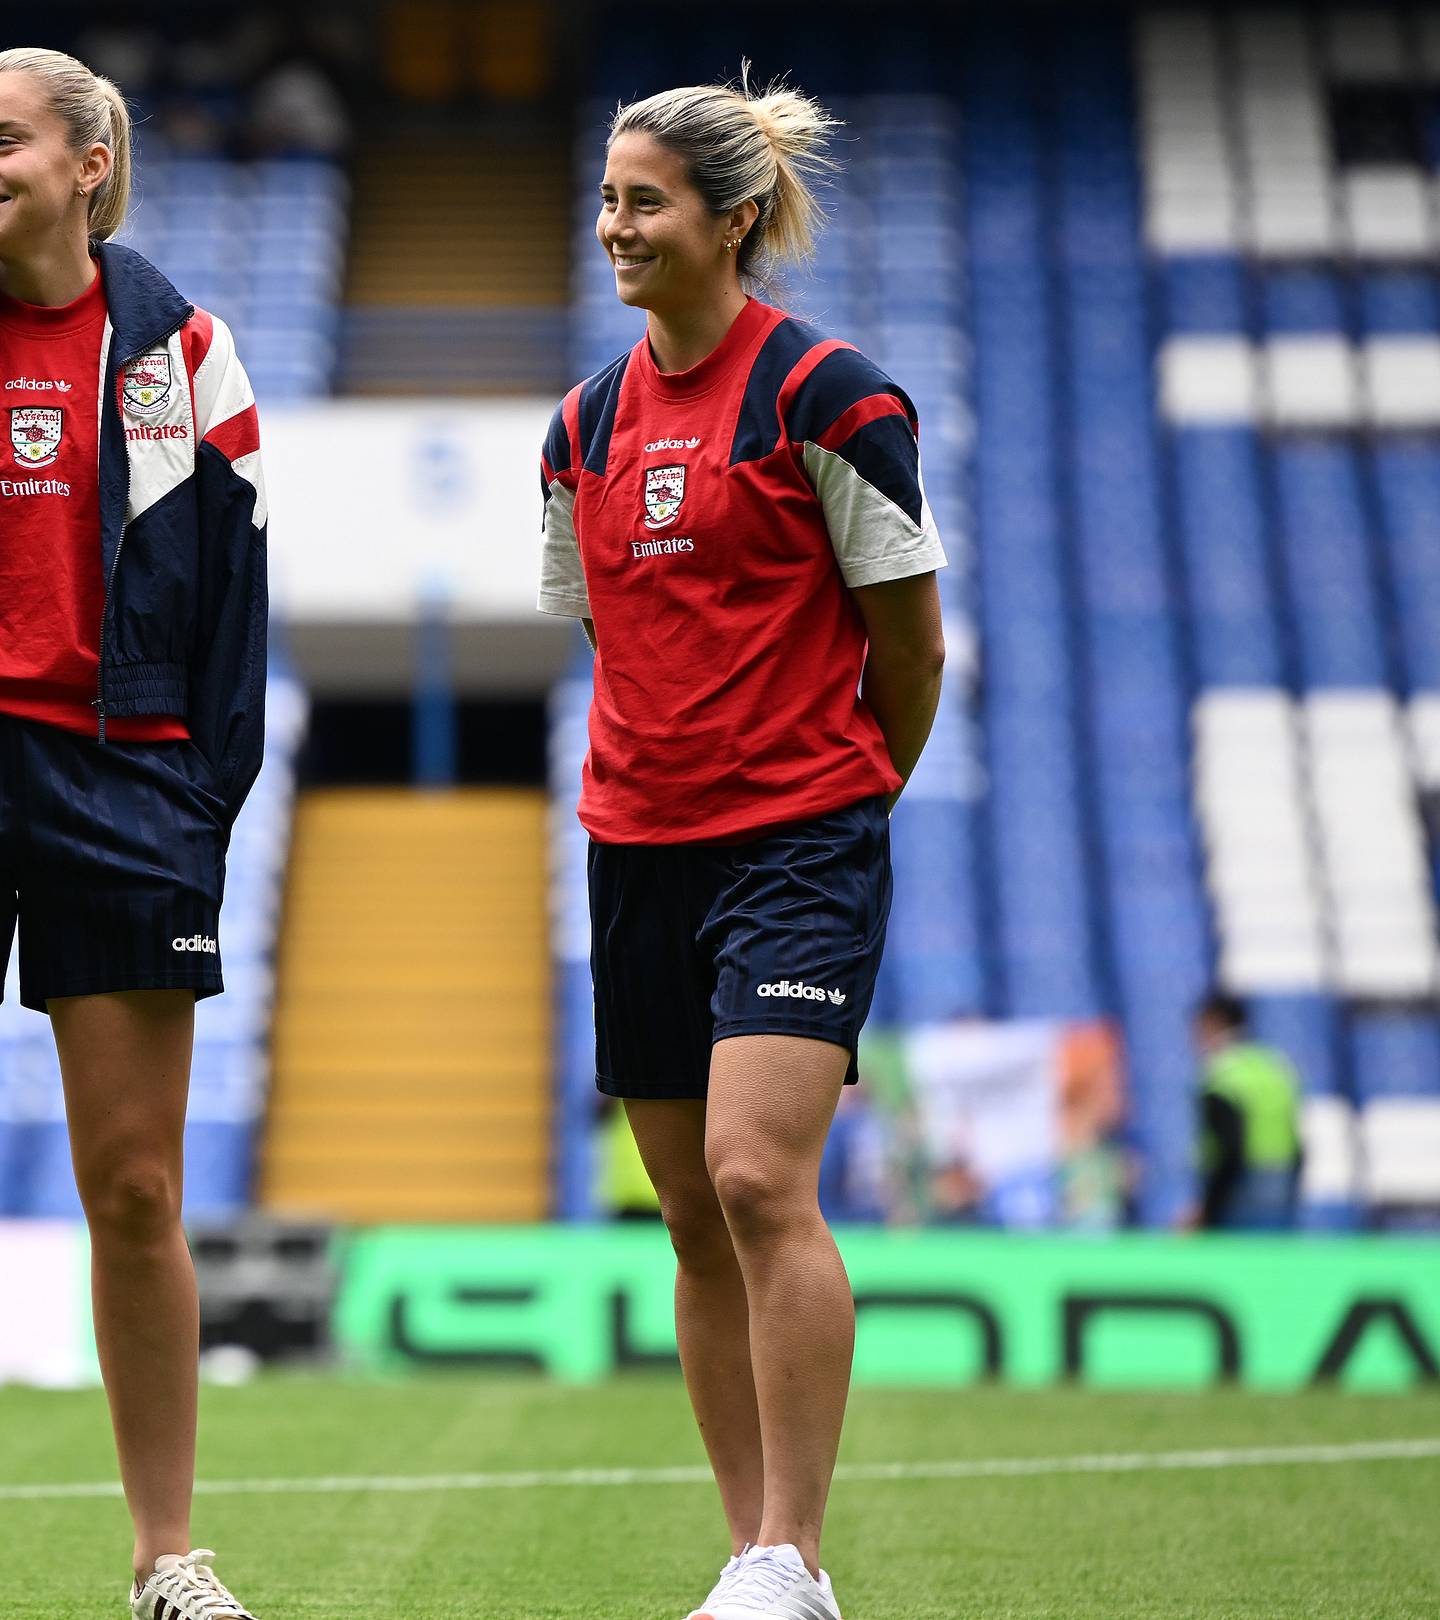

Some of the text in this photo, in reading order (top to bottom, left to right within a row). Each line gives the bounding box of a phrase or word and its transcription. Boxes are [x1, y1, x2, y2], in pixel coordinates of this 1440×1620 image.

[5, 376, 54, 391] adidas
[14, 410, 60, 421] Arsenal
[125, 423, 189, 441] mirates
[645, 438, 684, 452] adidas
[648, 468, 683, 482] Arsenal
[0, 478, 71, 497] Emirates
[632, 538, 694, 558] Emirates
[756, 980, 827, 1002] adidas
